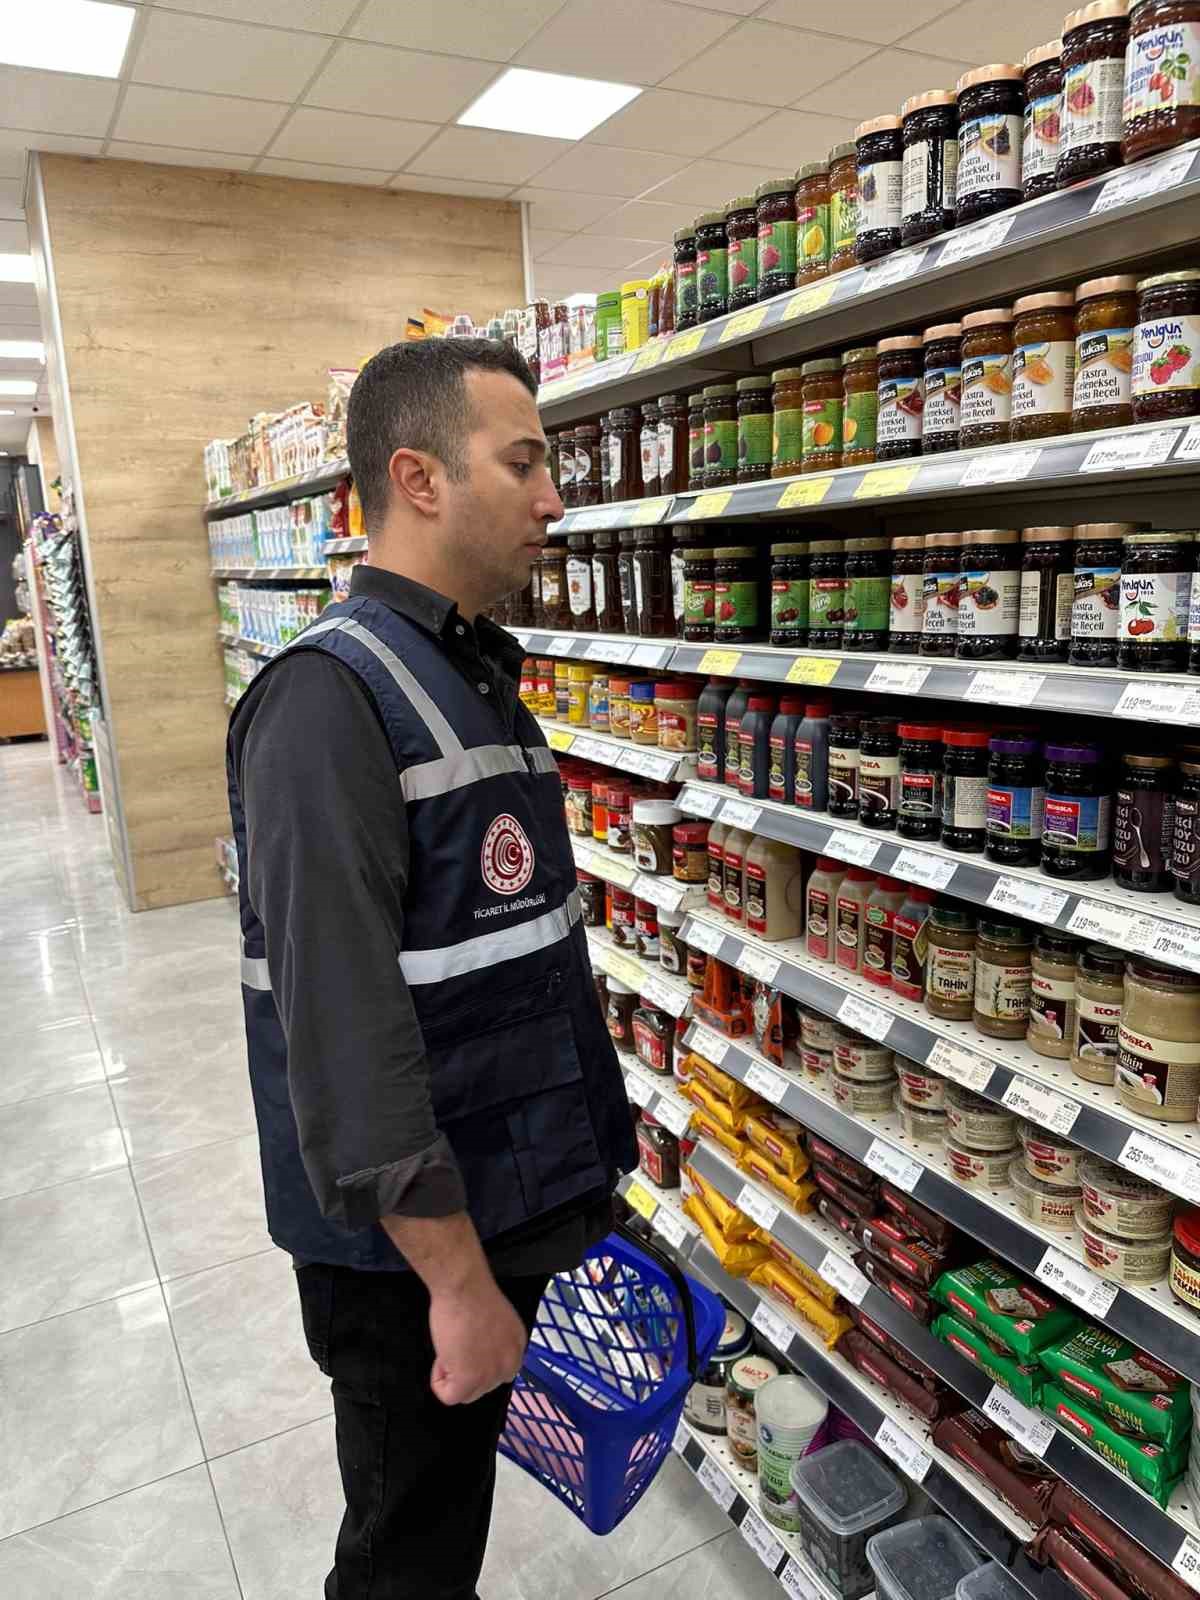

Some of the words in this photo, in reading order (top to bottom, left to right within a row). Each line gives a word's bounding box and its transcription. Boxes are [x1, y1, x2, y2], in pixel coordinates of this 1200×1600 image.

[473, 904, 503, 919] TİCARET
[1006, 998, 1025, 1009] TAH
[1094, 1006, 1120, 1017] KOS
[1076, 1331, 1117, 1358] HELVA
